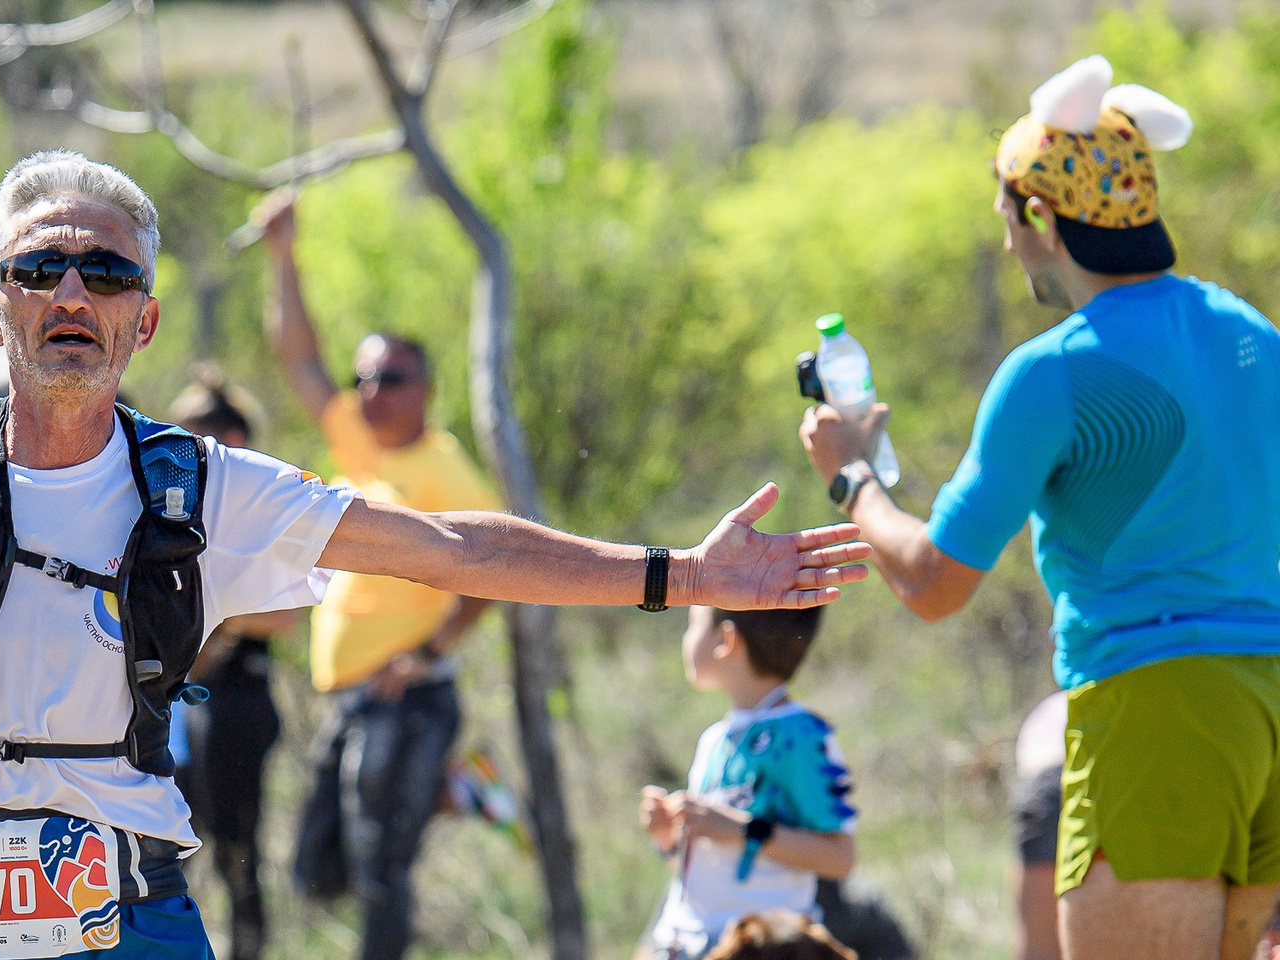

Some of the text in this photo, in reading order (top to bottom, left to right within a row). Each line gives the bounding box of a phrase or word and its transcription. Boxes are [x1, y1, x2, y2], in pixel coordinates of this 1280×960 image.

[83, 613, 126, 654] ЧАСТНО ОСНО
[8, 836, 27, 845] 22K
